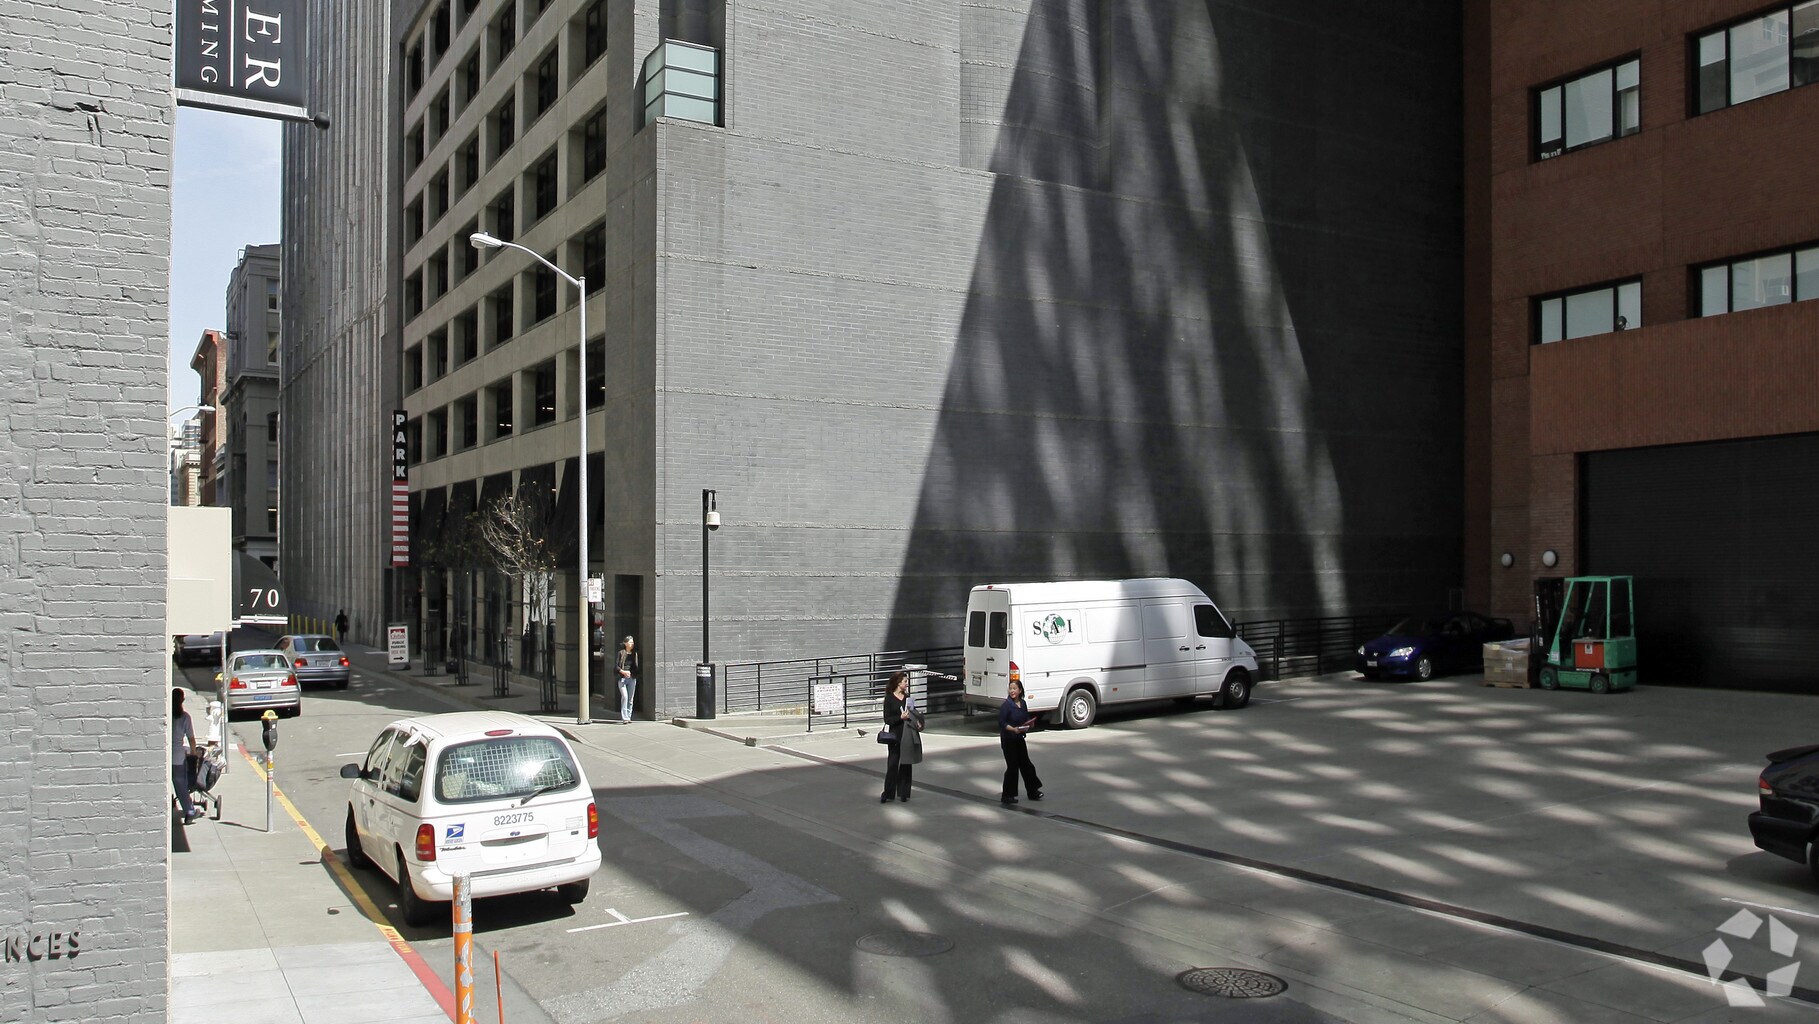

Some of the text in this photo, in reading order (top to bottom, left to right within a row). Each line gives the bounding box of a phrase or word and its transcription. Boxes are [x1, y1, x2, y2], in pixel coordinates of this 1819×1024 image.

[395, 414, 406, 478] PARK
[250, 588, 280, 609] 70
[493, 812, 534, 826] 8223775
[5, 931, 81, 963] NCES
